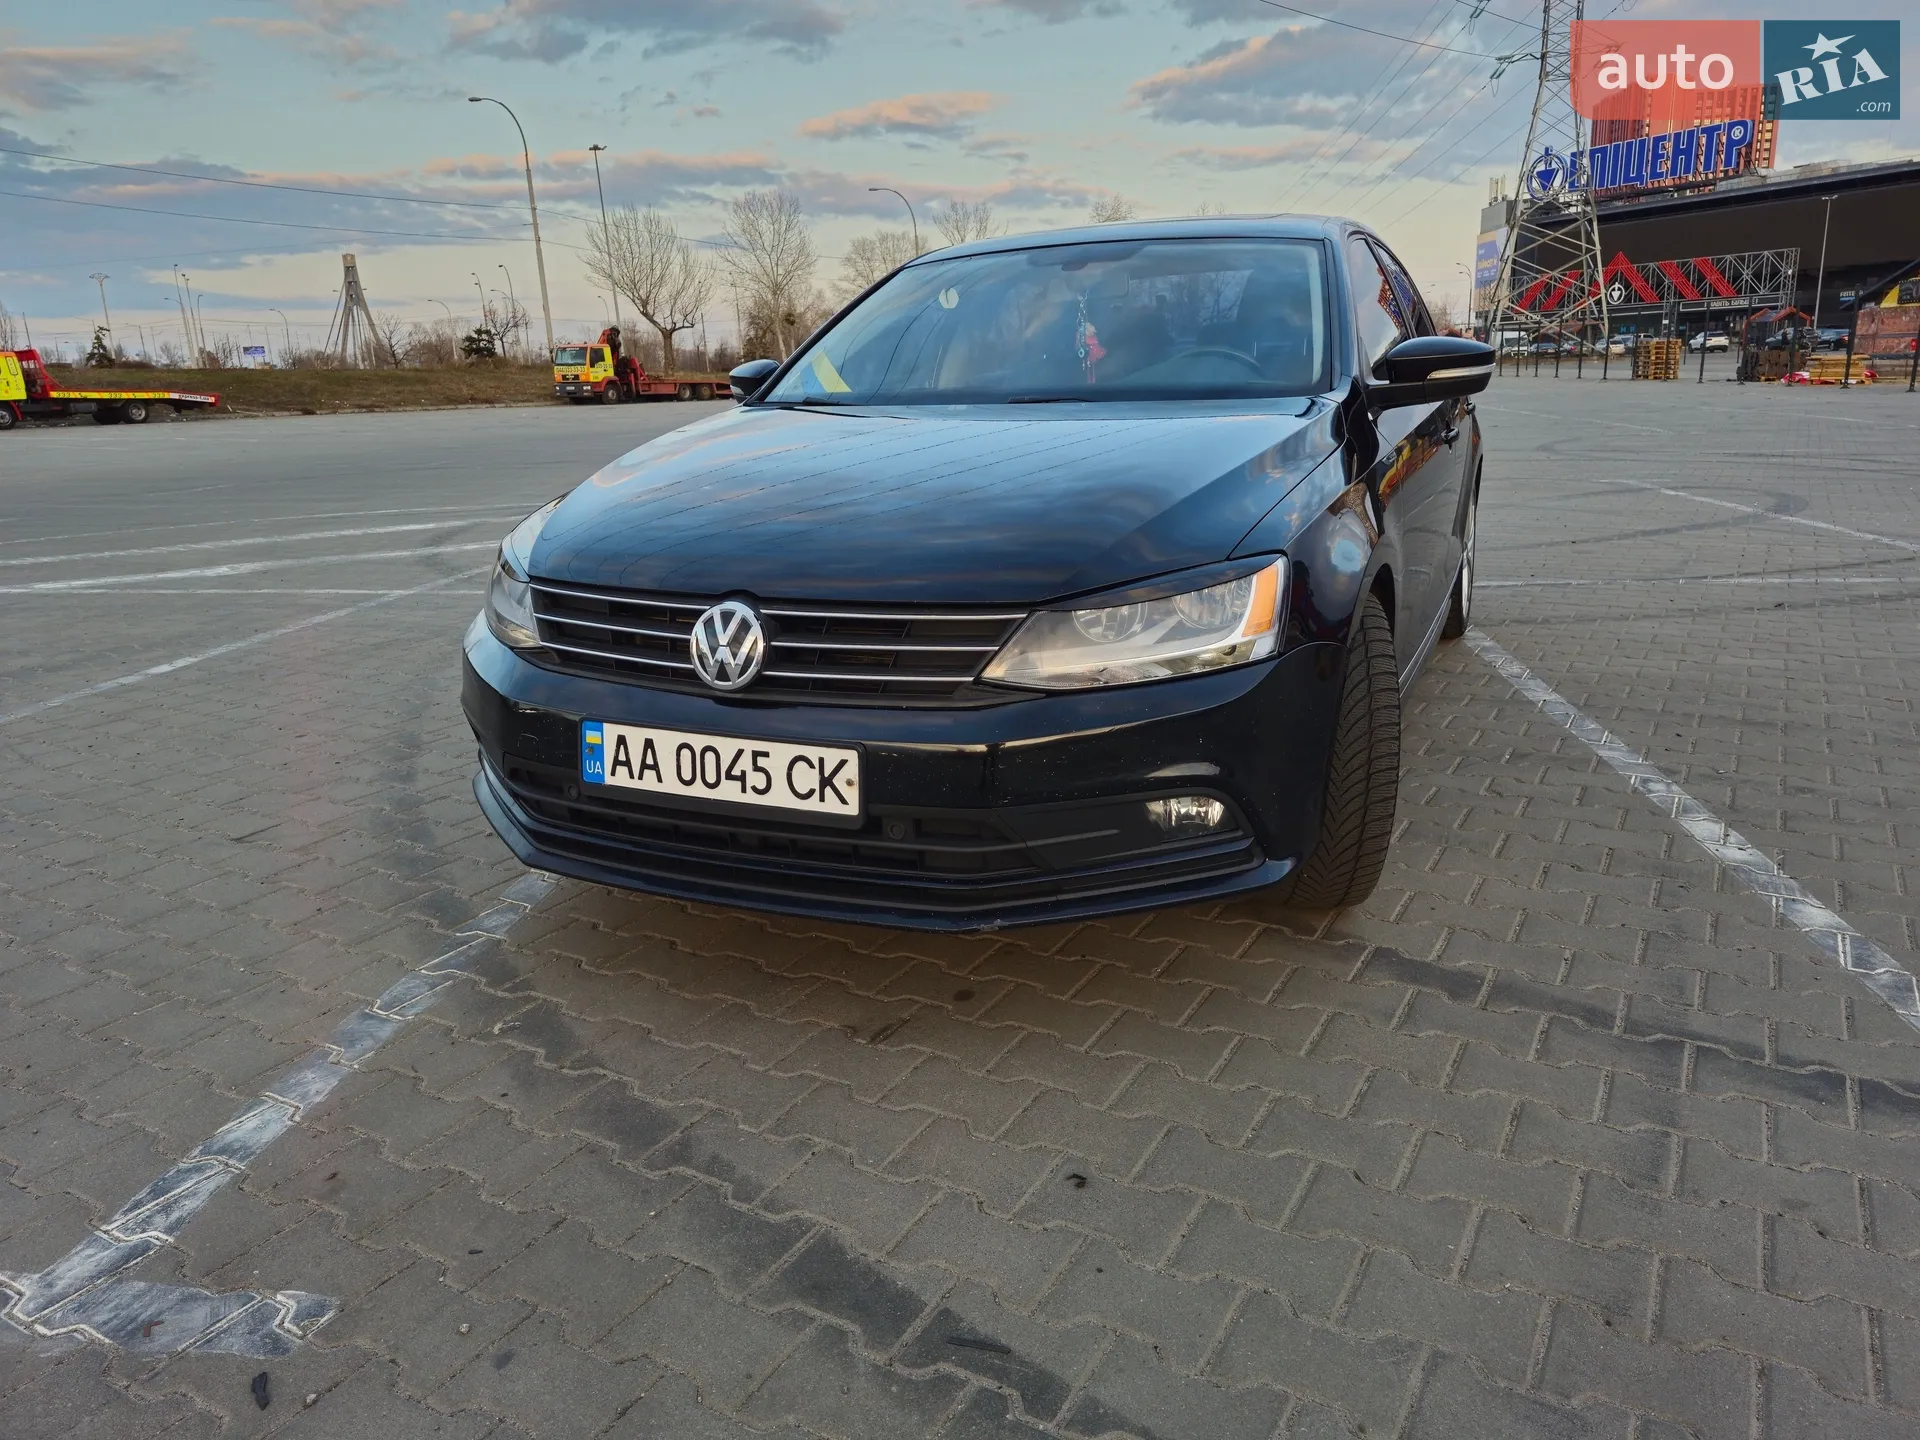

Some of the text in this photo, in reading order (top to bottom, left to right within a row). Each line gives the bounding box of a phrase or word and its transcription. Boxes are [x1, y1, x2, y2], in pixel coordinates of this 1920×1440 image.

[1568, 119, 1752, 191] ЕПІЦЕНТР
[586, 760, 603, 775] UA
[610, 734, 850, 806] AA 0045 CK
